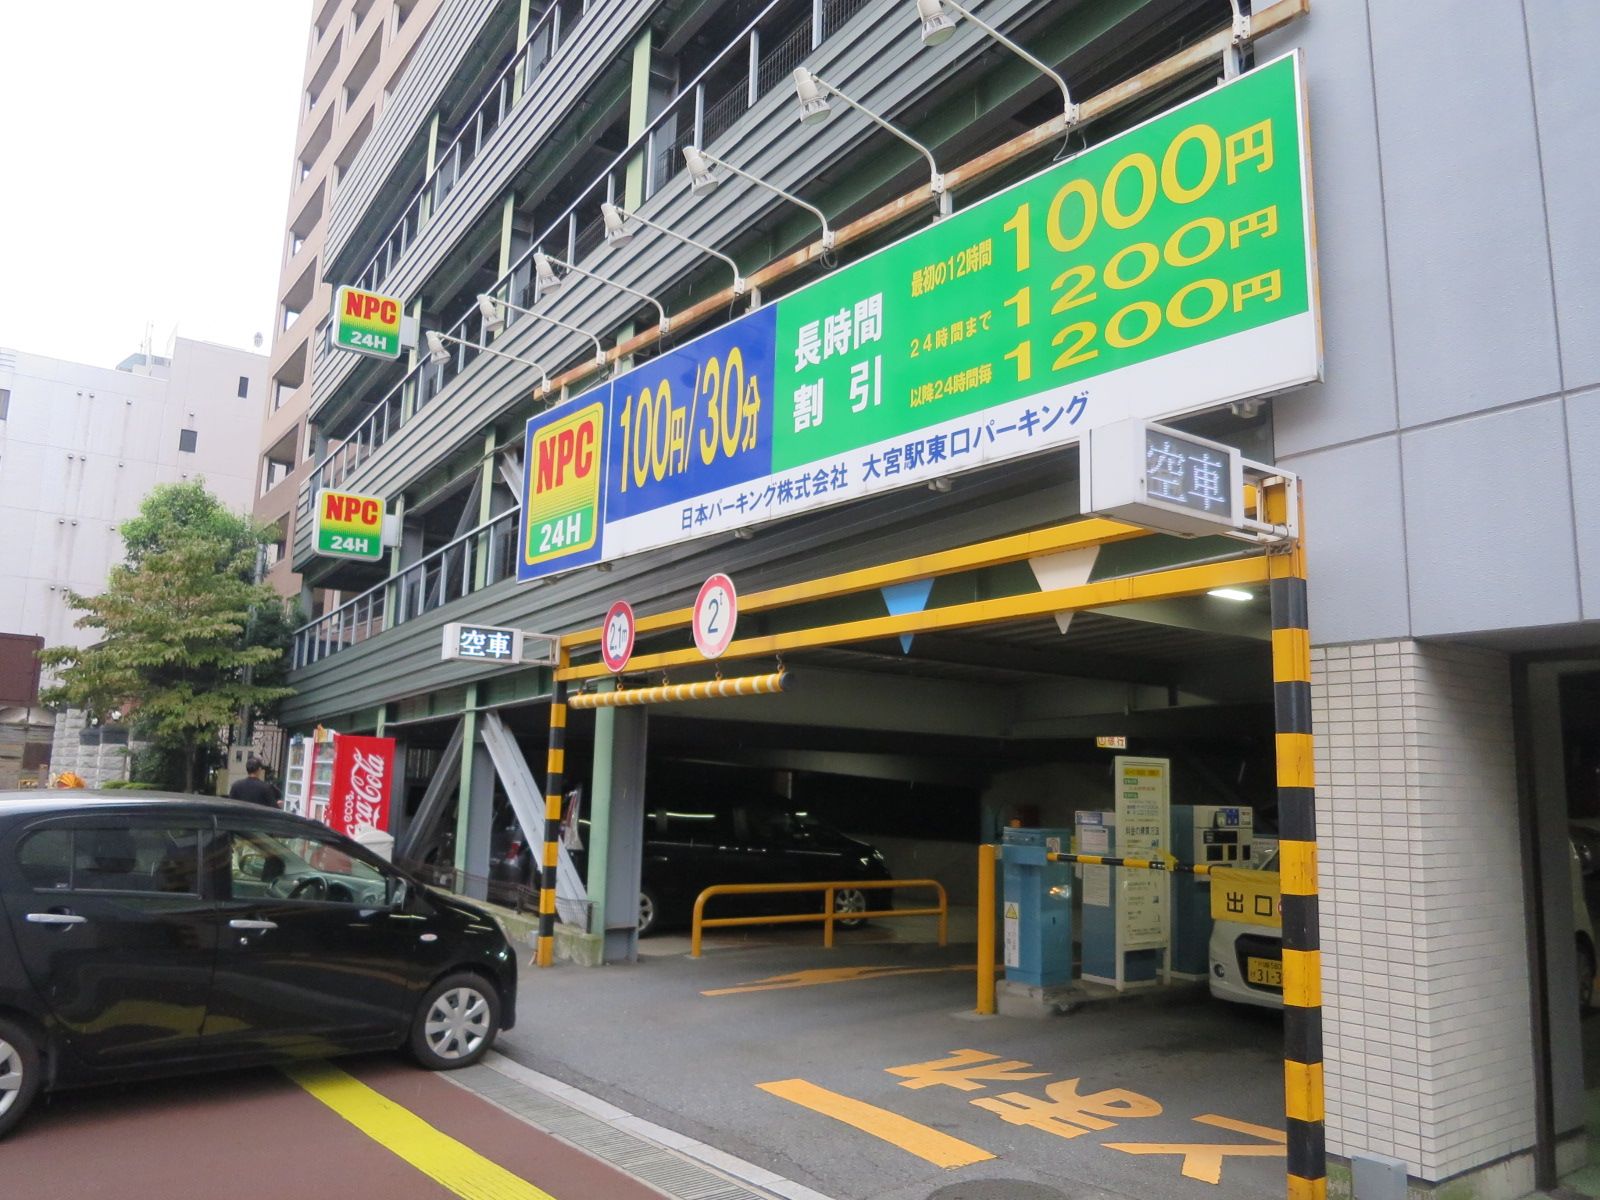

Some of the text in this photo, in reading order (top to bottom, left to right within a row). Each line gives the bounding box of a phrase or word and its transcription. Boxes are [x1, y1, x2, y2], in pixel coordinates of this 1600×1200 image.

[911, 118, 1273, 298] 最初の12時間 1000円
[346, 291, 397, 325] NPC
[910, 204, 1278, 359] 24時間まで 1200円
[350, 331, 387, 350] 24H
[794, 292, 883, 373] 長時間
[910, 269, 1281, 409] 以降24時間毎 1200円
[620, 346, 761, 493] 100円/30分
[536, 421, 593, 494] NPC
[681, 391, 1090, 531] 日本パーキング株式会社 大宮駅東口パーキング
[1147, 441, 1225, 511] 空車
[326, 494, 378, 525] NPC
[330, 535, 368, 553] 24H
[539, 513, 581, 553] 24H
[460, 630, 511, 659] 空車
[609, 622, 627, 651] 2.1m
[346, 746, 385, 840] Cca-Cola
[1226, 891, 1273, 917] 出口
